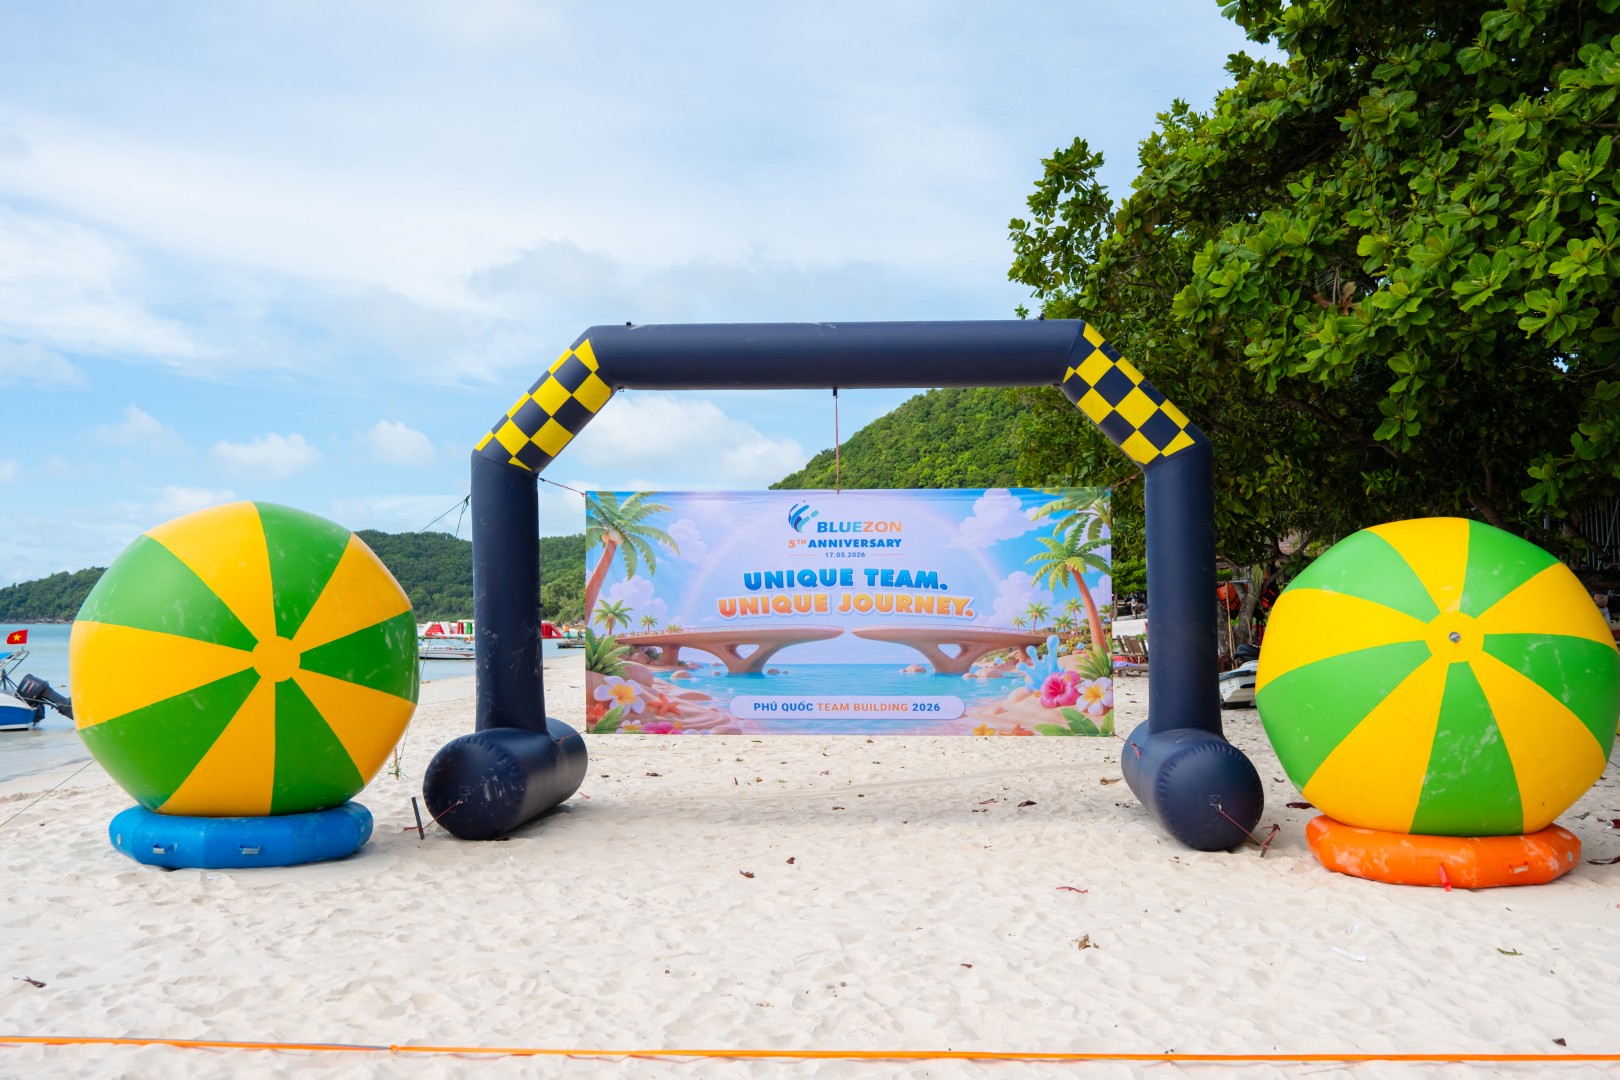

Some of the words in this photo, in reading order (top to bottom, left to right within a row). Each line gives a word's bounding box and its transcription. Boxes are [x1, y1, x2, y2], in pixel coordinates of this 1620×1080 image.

[817, 521, 902, 533] BLUEZON
[808, 538, 902, 548] ANNIVERSARY
[744, 568, 854, 591] UNIQUE
[864, 568, 948, 591] TEAM.
[718, 594, 829, 617] UNIQUE
[837, 593, 974, 617] JOURNEY.
[753, 701, 778, 712] PHÚ
[781, 700, 814, 712] QUỐC
[818, 703, 850, 712] TEAM
[853, 703, 909, 712] BUILDING
[912, 702, 941, 712] 2026
